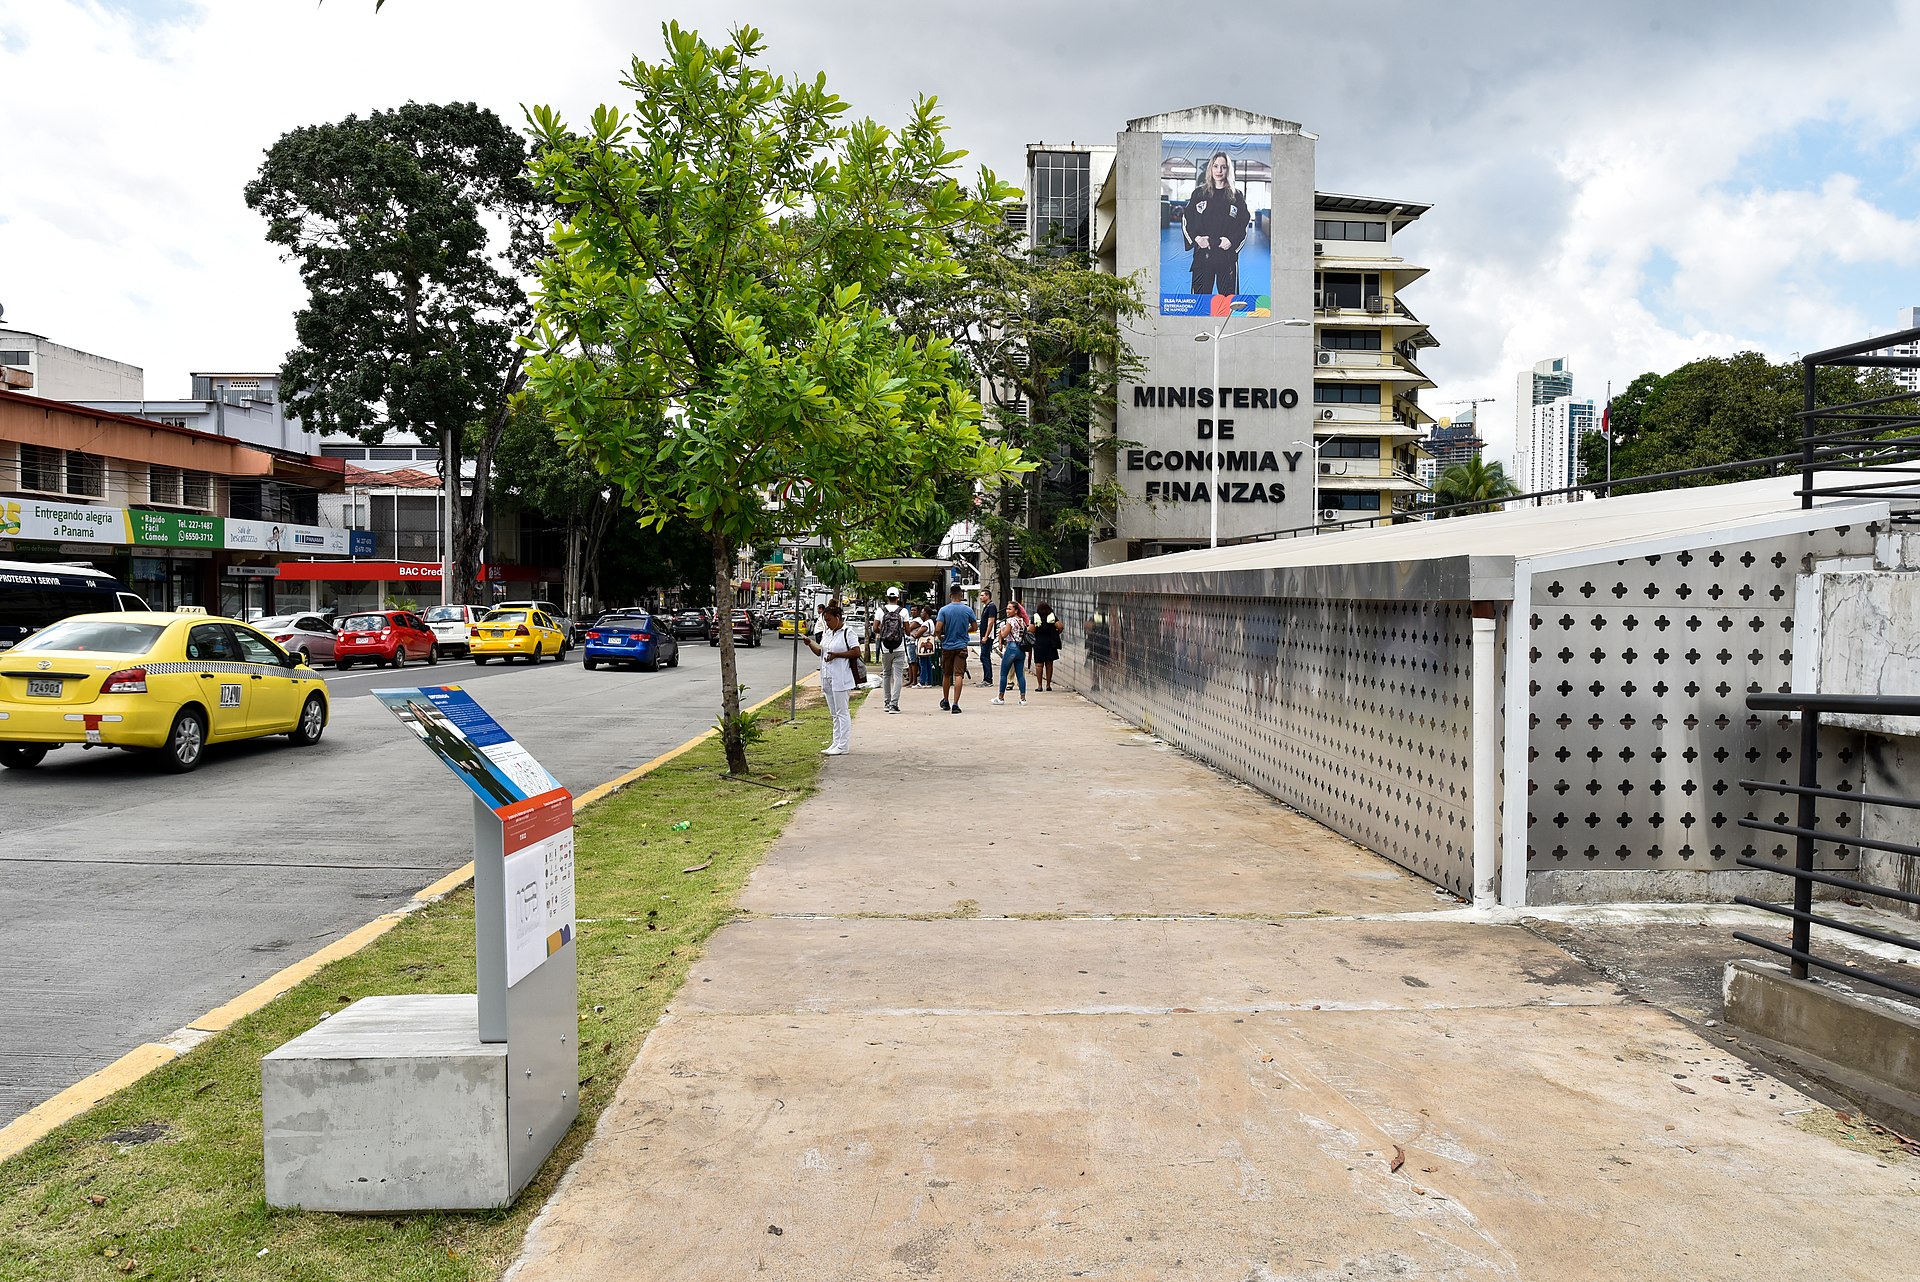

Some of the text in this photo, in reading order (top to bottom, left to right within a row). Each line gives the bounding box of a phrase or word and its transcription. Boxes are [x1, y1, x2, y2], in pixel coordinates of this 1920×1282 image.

[1134, 386, 1299, 409] MINISTERIO
[1197, 418, 1235, 440] DE
[1127, 449, 1303, 472] ECONOMIA Y
[1146, 481, 1286, 504] FINANZAS
[35, 505, 83, 522] Entregando
[145, 514, 213, 529] Rápido Tel. 227-1487
[53, 525, 95, 538] a Panamá
[145, 523, 213, 542] Fácil 6550-3712
[145, 533, 169, 542] Cómodo
[0, 574, 33, 584] PROTEGER
[38, 576, 61, 586] SERVIR
[399, 567, 419, 576] BAC
